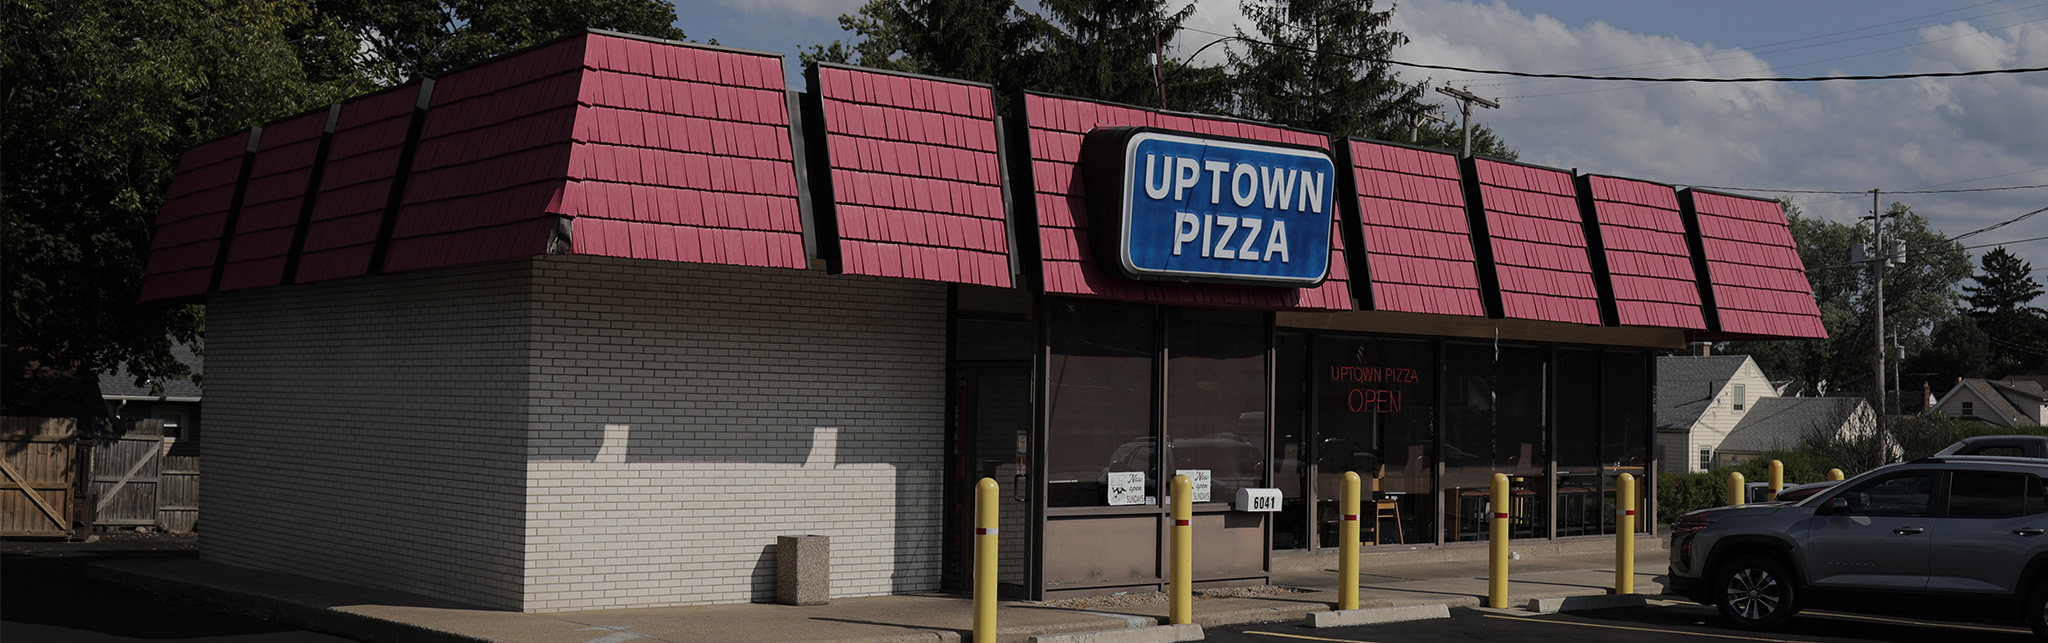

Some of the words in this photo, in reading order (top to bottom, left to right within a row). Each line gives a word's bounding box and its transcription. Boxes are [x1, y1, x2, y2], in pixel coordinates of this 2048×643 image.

[1144, 152, 1325, 214] UPTOWN
[1173, 211, 1290, 263] PIZZA
[1330, 366, 1382, 382] UPTOWN
[1385, 368, 1419, 383] PIZZA
[1348, 388, 1401, 413] OPEN
[1254, 496, 1276, 509] 6041
